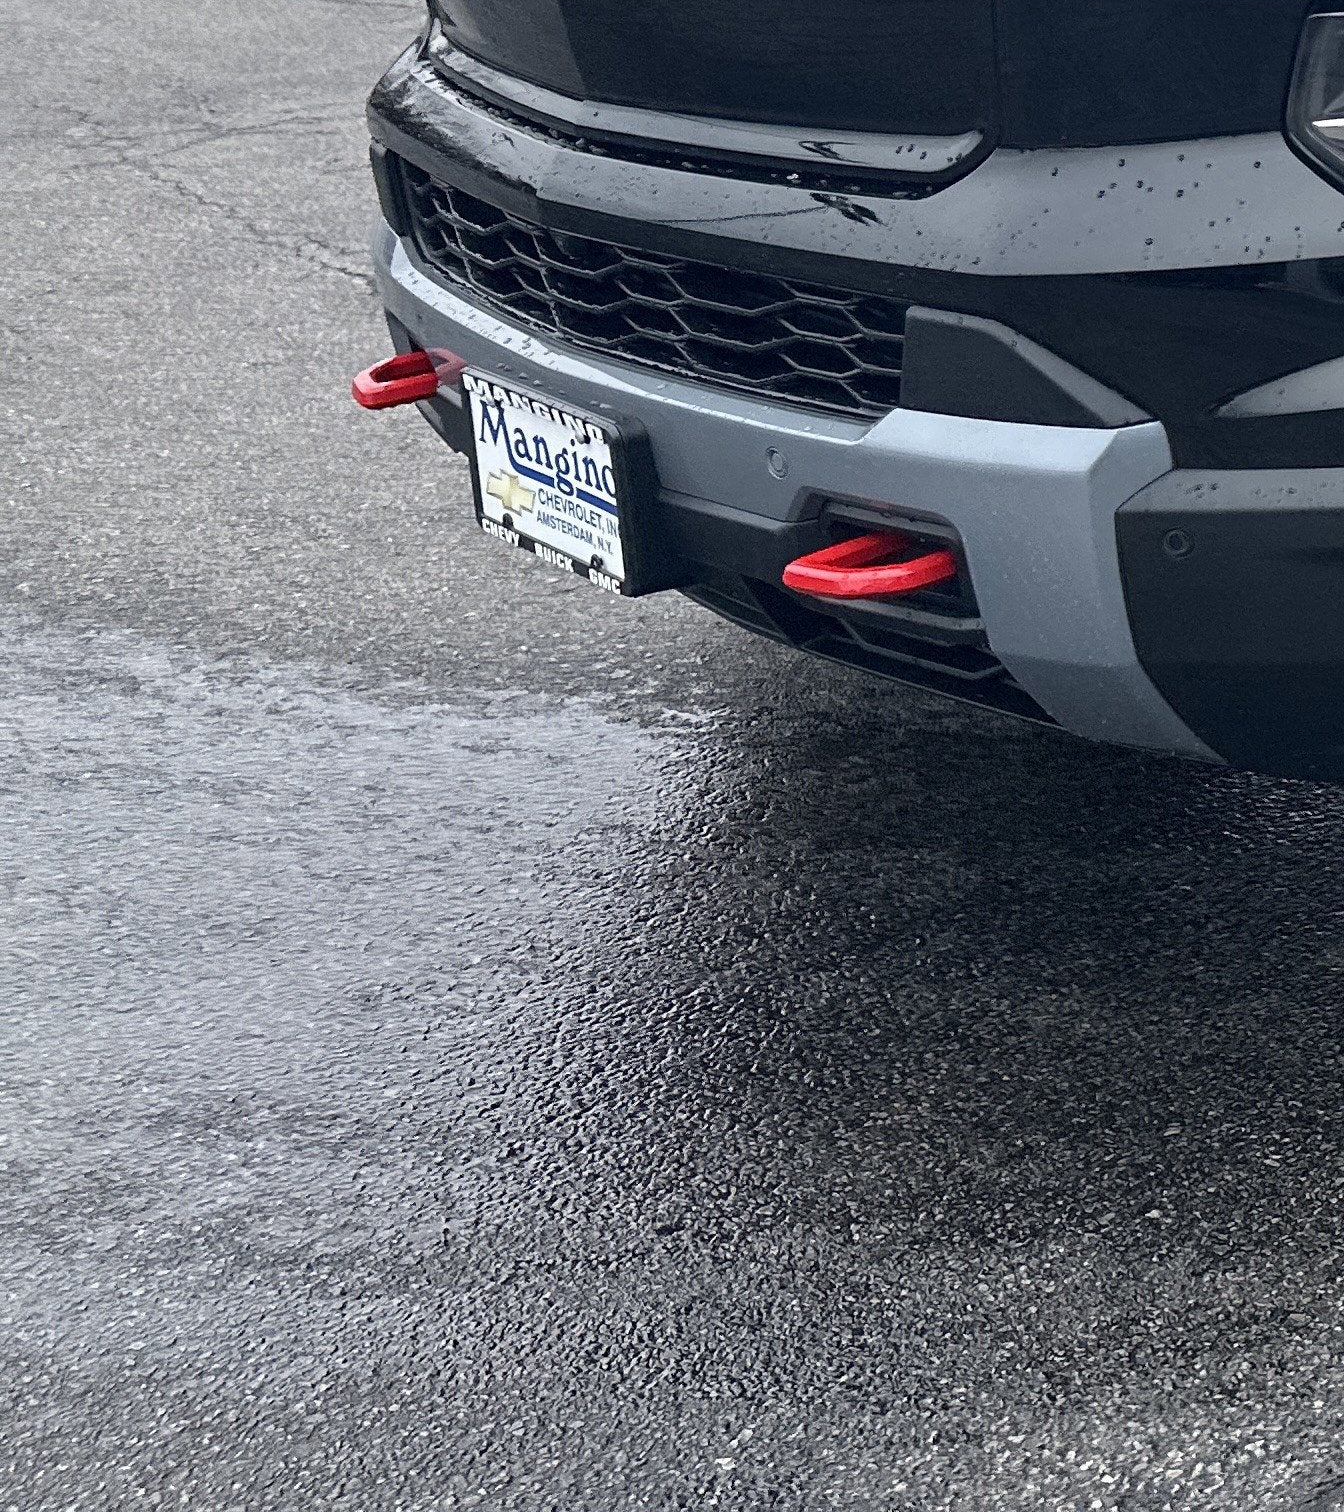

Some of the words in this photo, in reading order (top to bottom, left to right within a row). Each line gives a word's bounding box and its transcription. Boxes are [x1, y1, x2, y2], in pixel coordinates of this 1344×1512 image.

[462, 373, 604, 444] MANGINO
[537, 510, 596, 549] AMSTERDAM,
[538, 488, 604, 534] CHEVROLET,
[482, 518, 520, 547] CHEVY
[535, 543, 575, 573] BUICK
[589, 569, 621, 595] GMC
